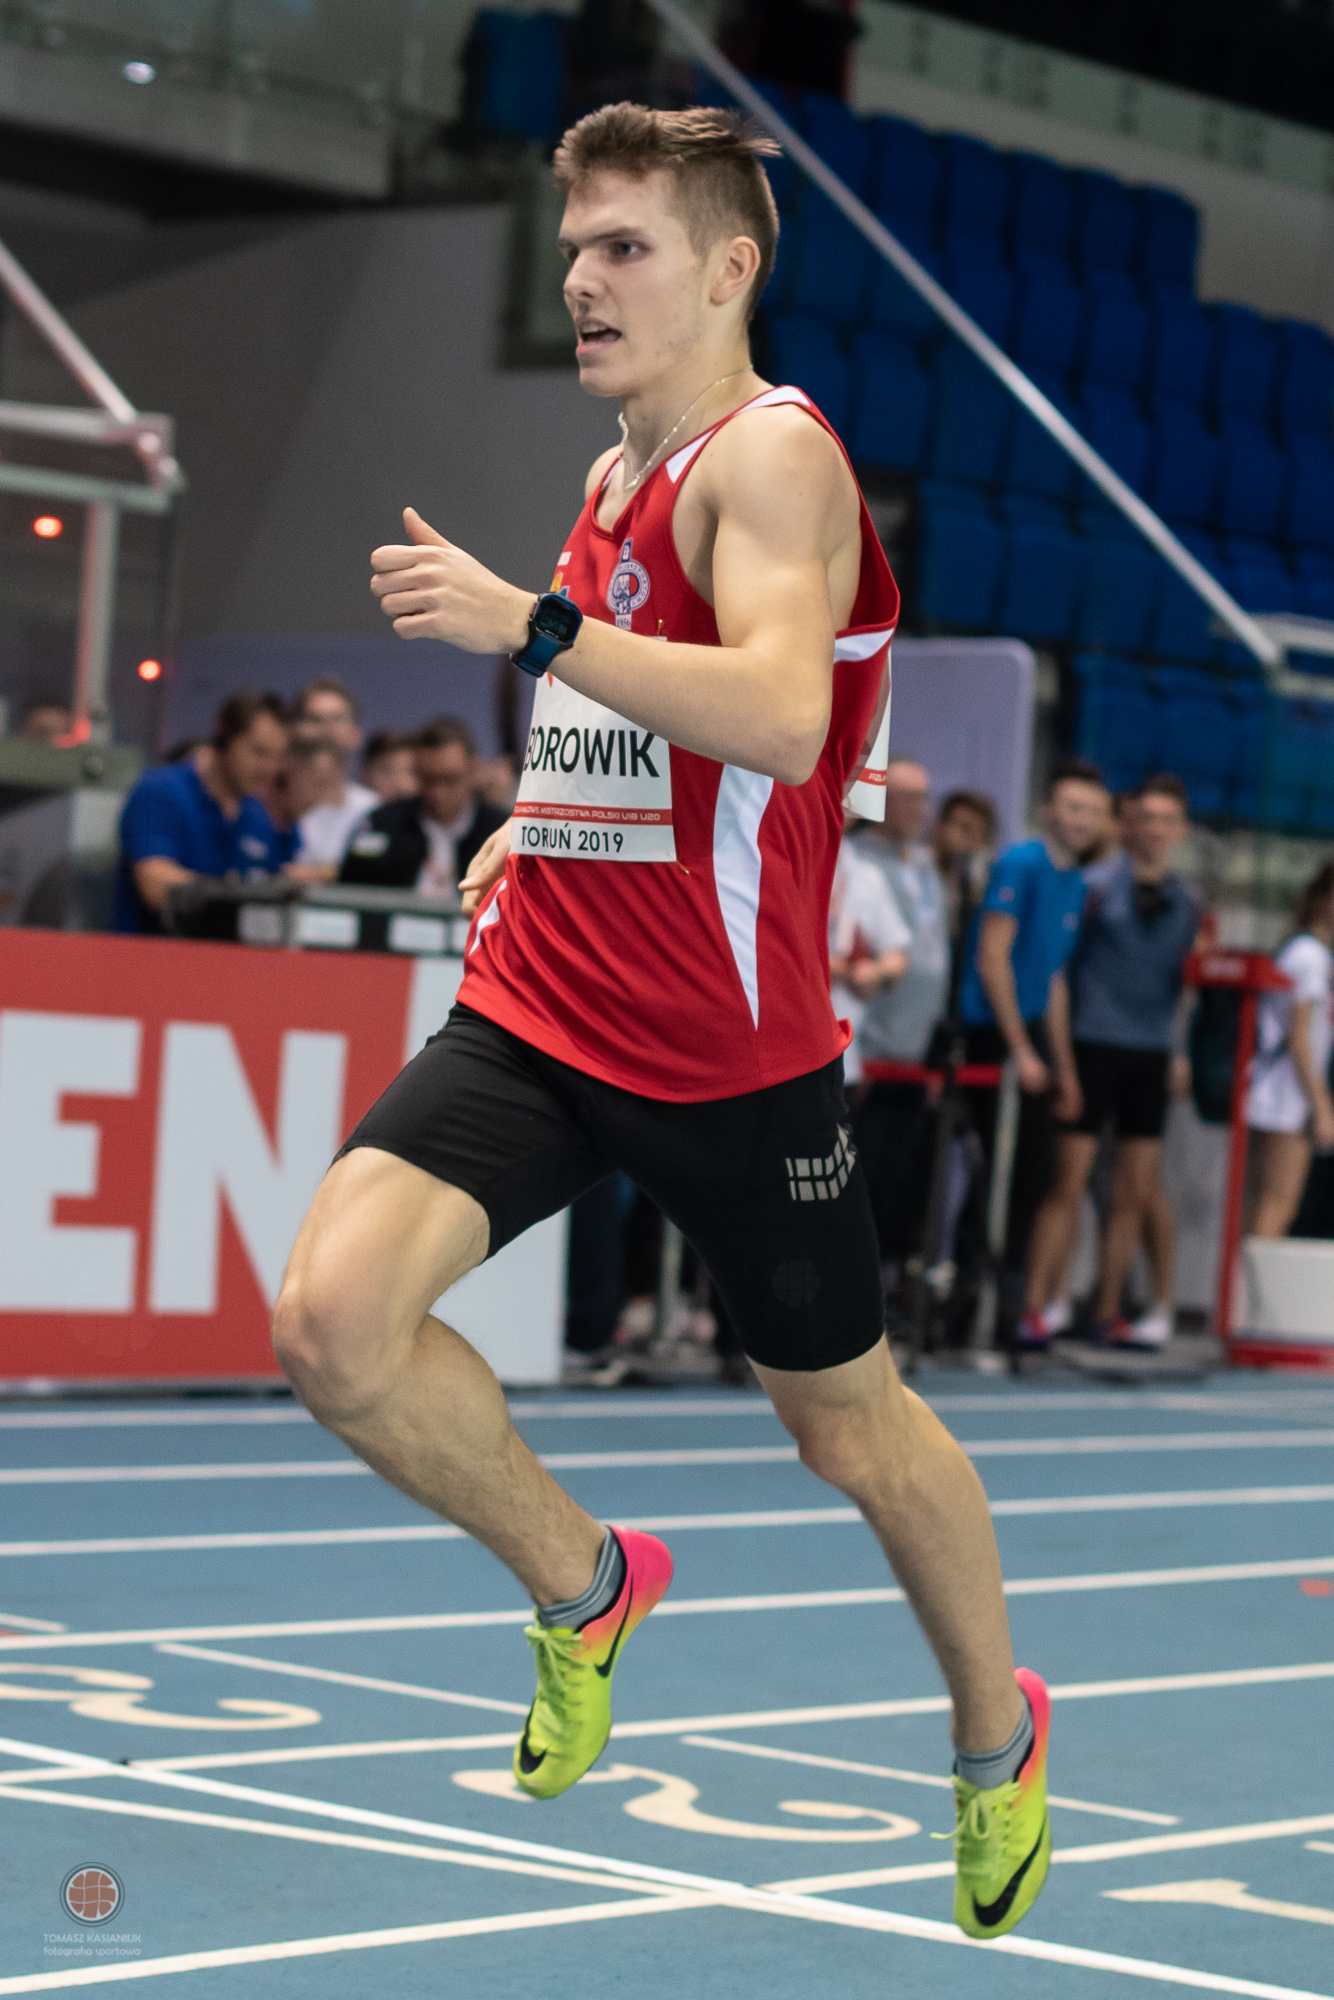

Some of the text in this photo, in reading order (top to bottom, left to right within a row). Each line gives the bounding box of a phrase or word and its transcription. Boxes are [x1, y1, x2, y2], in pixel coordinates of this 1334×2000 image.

[523, 726, 660, 778] BOROWIK
[591, 810, 620, 820] POLSKI
[640, 813, 661, 821] U20
[521, 823, 624, 853] TORUŃ 2019
